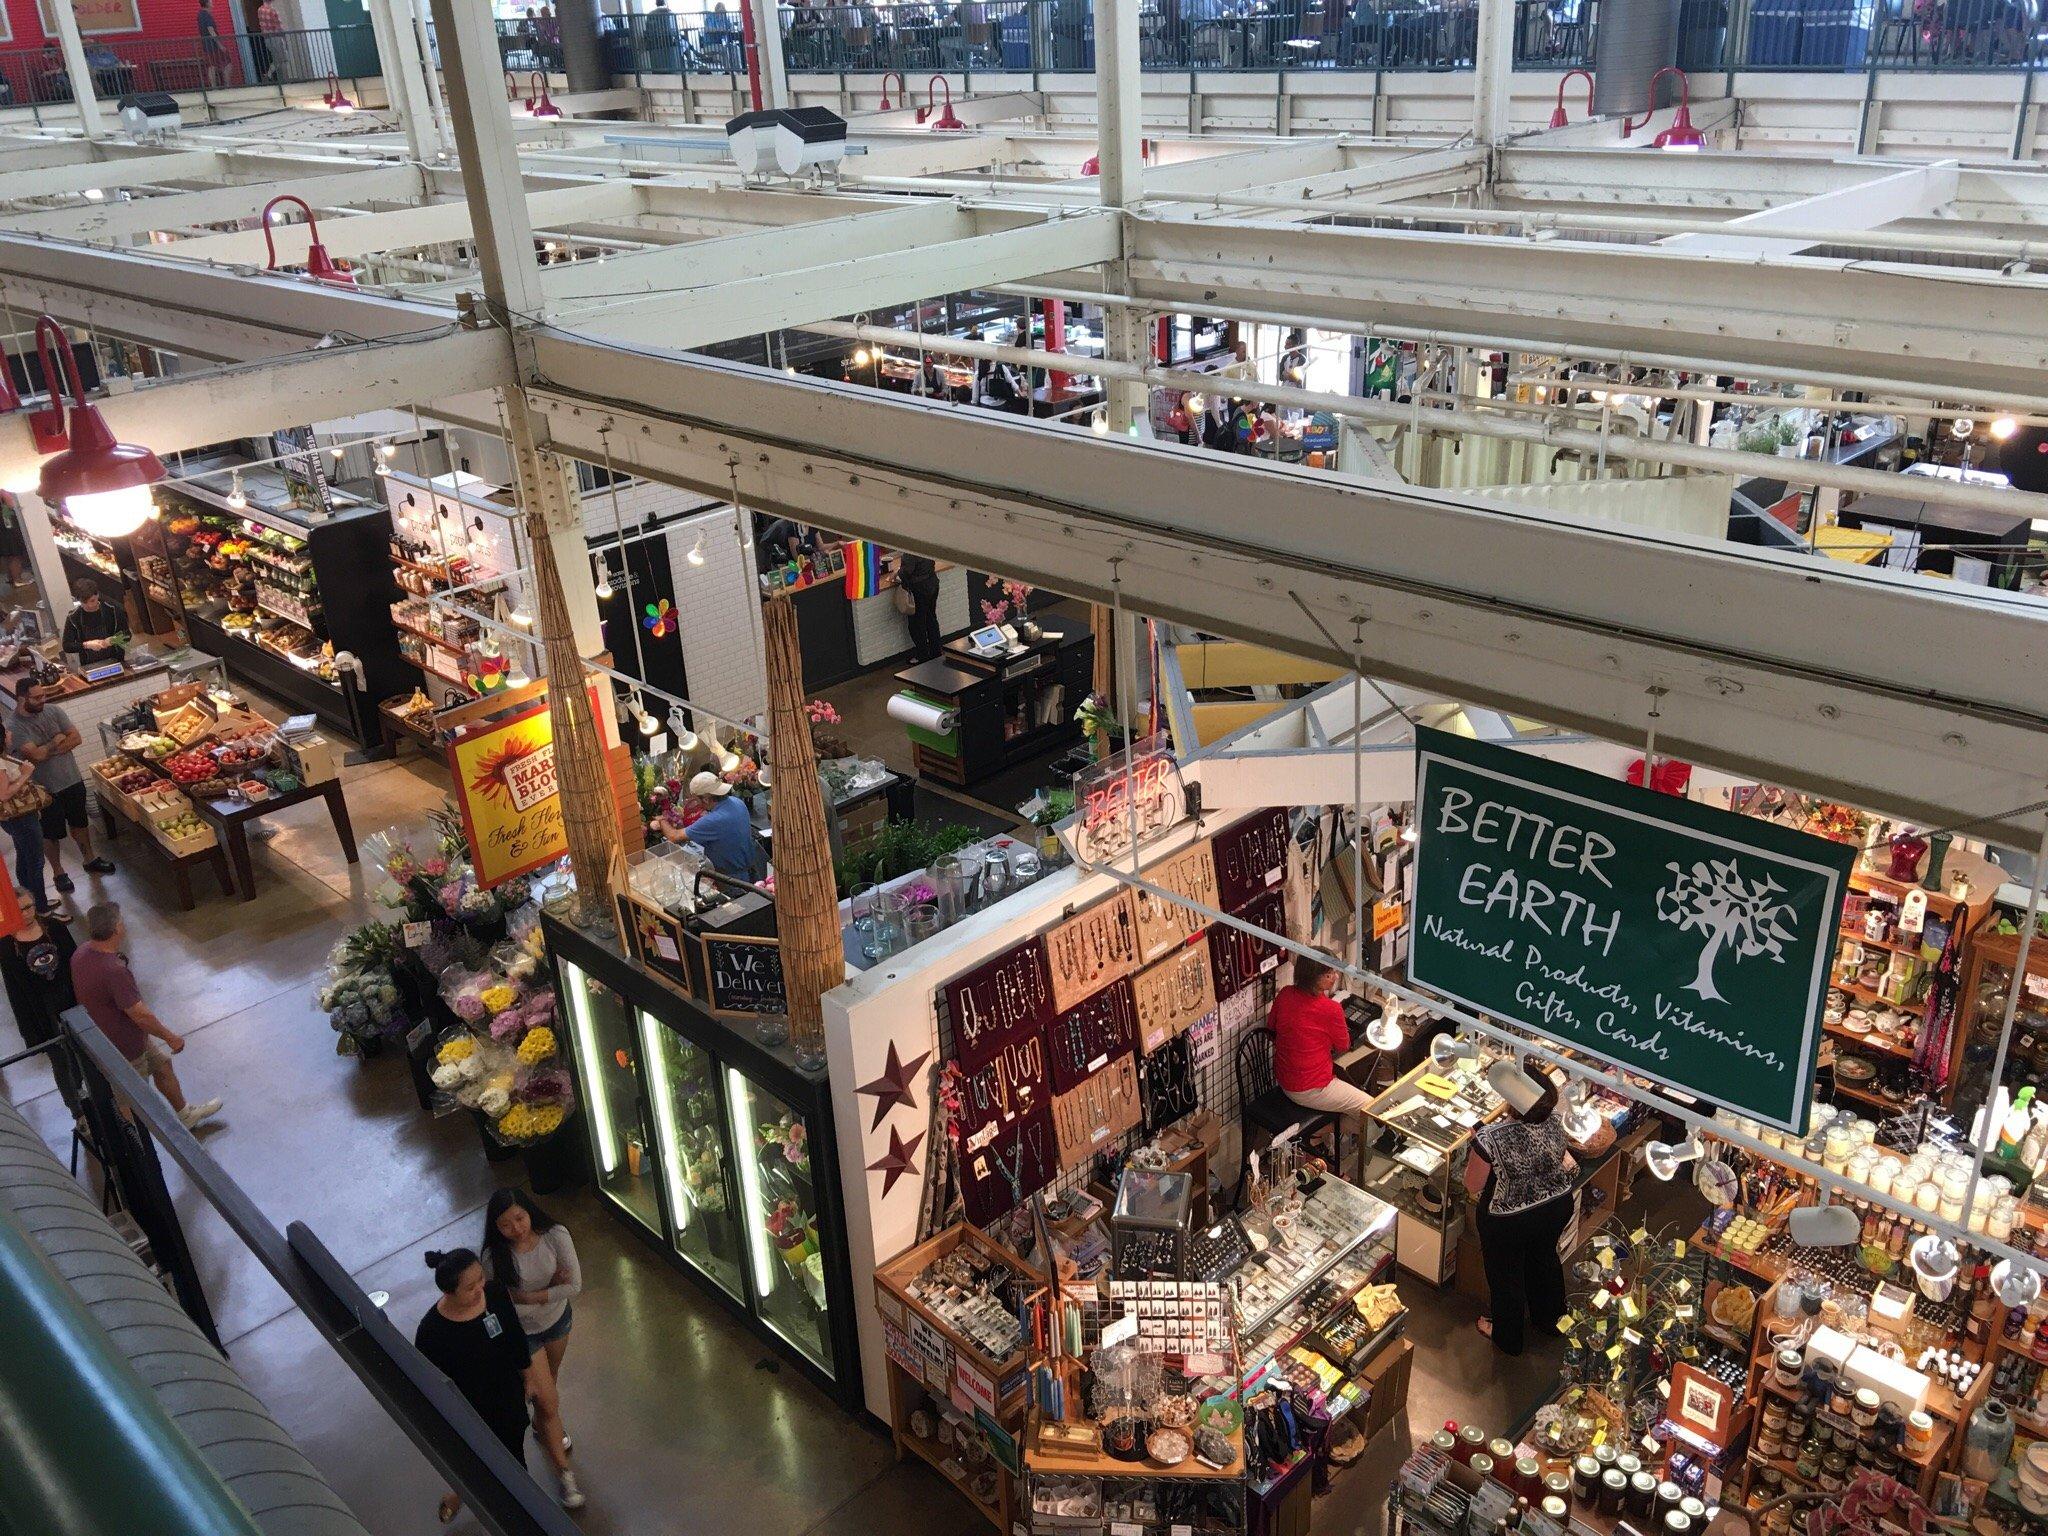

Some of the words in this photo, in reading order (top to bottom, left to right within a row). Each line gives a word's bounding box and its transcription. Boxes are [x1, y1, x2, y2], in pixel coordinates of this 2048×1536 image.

[306, 435, 323, 474] VEGTABLE
[510, 755, 538, 775] FRESH
[511, 756, 556, 788] MAR
[516, 768, 558, 800] BLOO
[521, 784, 556, 807] EVER
[1086, 758, 1170, 832] BETTER
[488, 816, 526, 848] Fresh
[1437, 787, 1615, 888] BETTER
[510, 839, 529, 858] &
[1459, 863, 1620, 956] EARTH
[730, 953, 765, 975] We
[715, 970, 784, 994] Deliver
[1424, 915, 1513, 962] Natural
[1525, 945, 1638, 1015] Products,
[1656, 994, 1785, 1072] Vitamins,
[1516, 982, 1581, 1029] Gifts,
[1596, 1012, 1670, 1061] Cards
[914, 1328, 941, 1355] REPAIR
[921, 1322, 932, 1338] WE
[912, 1338, 944, 1367] JEWELRY
[957, 1365, 992, 1404] WELCOME
